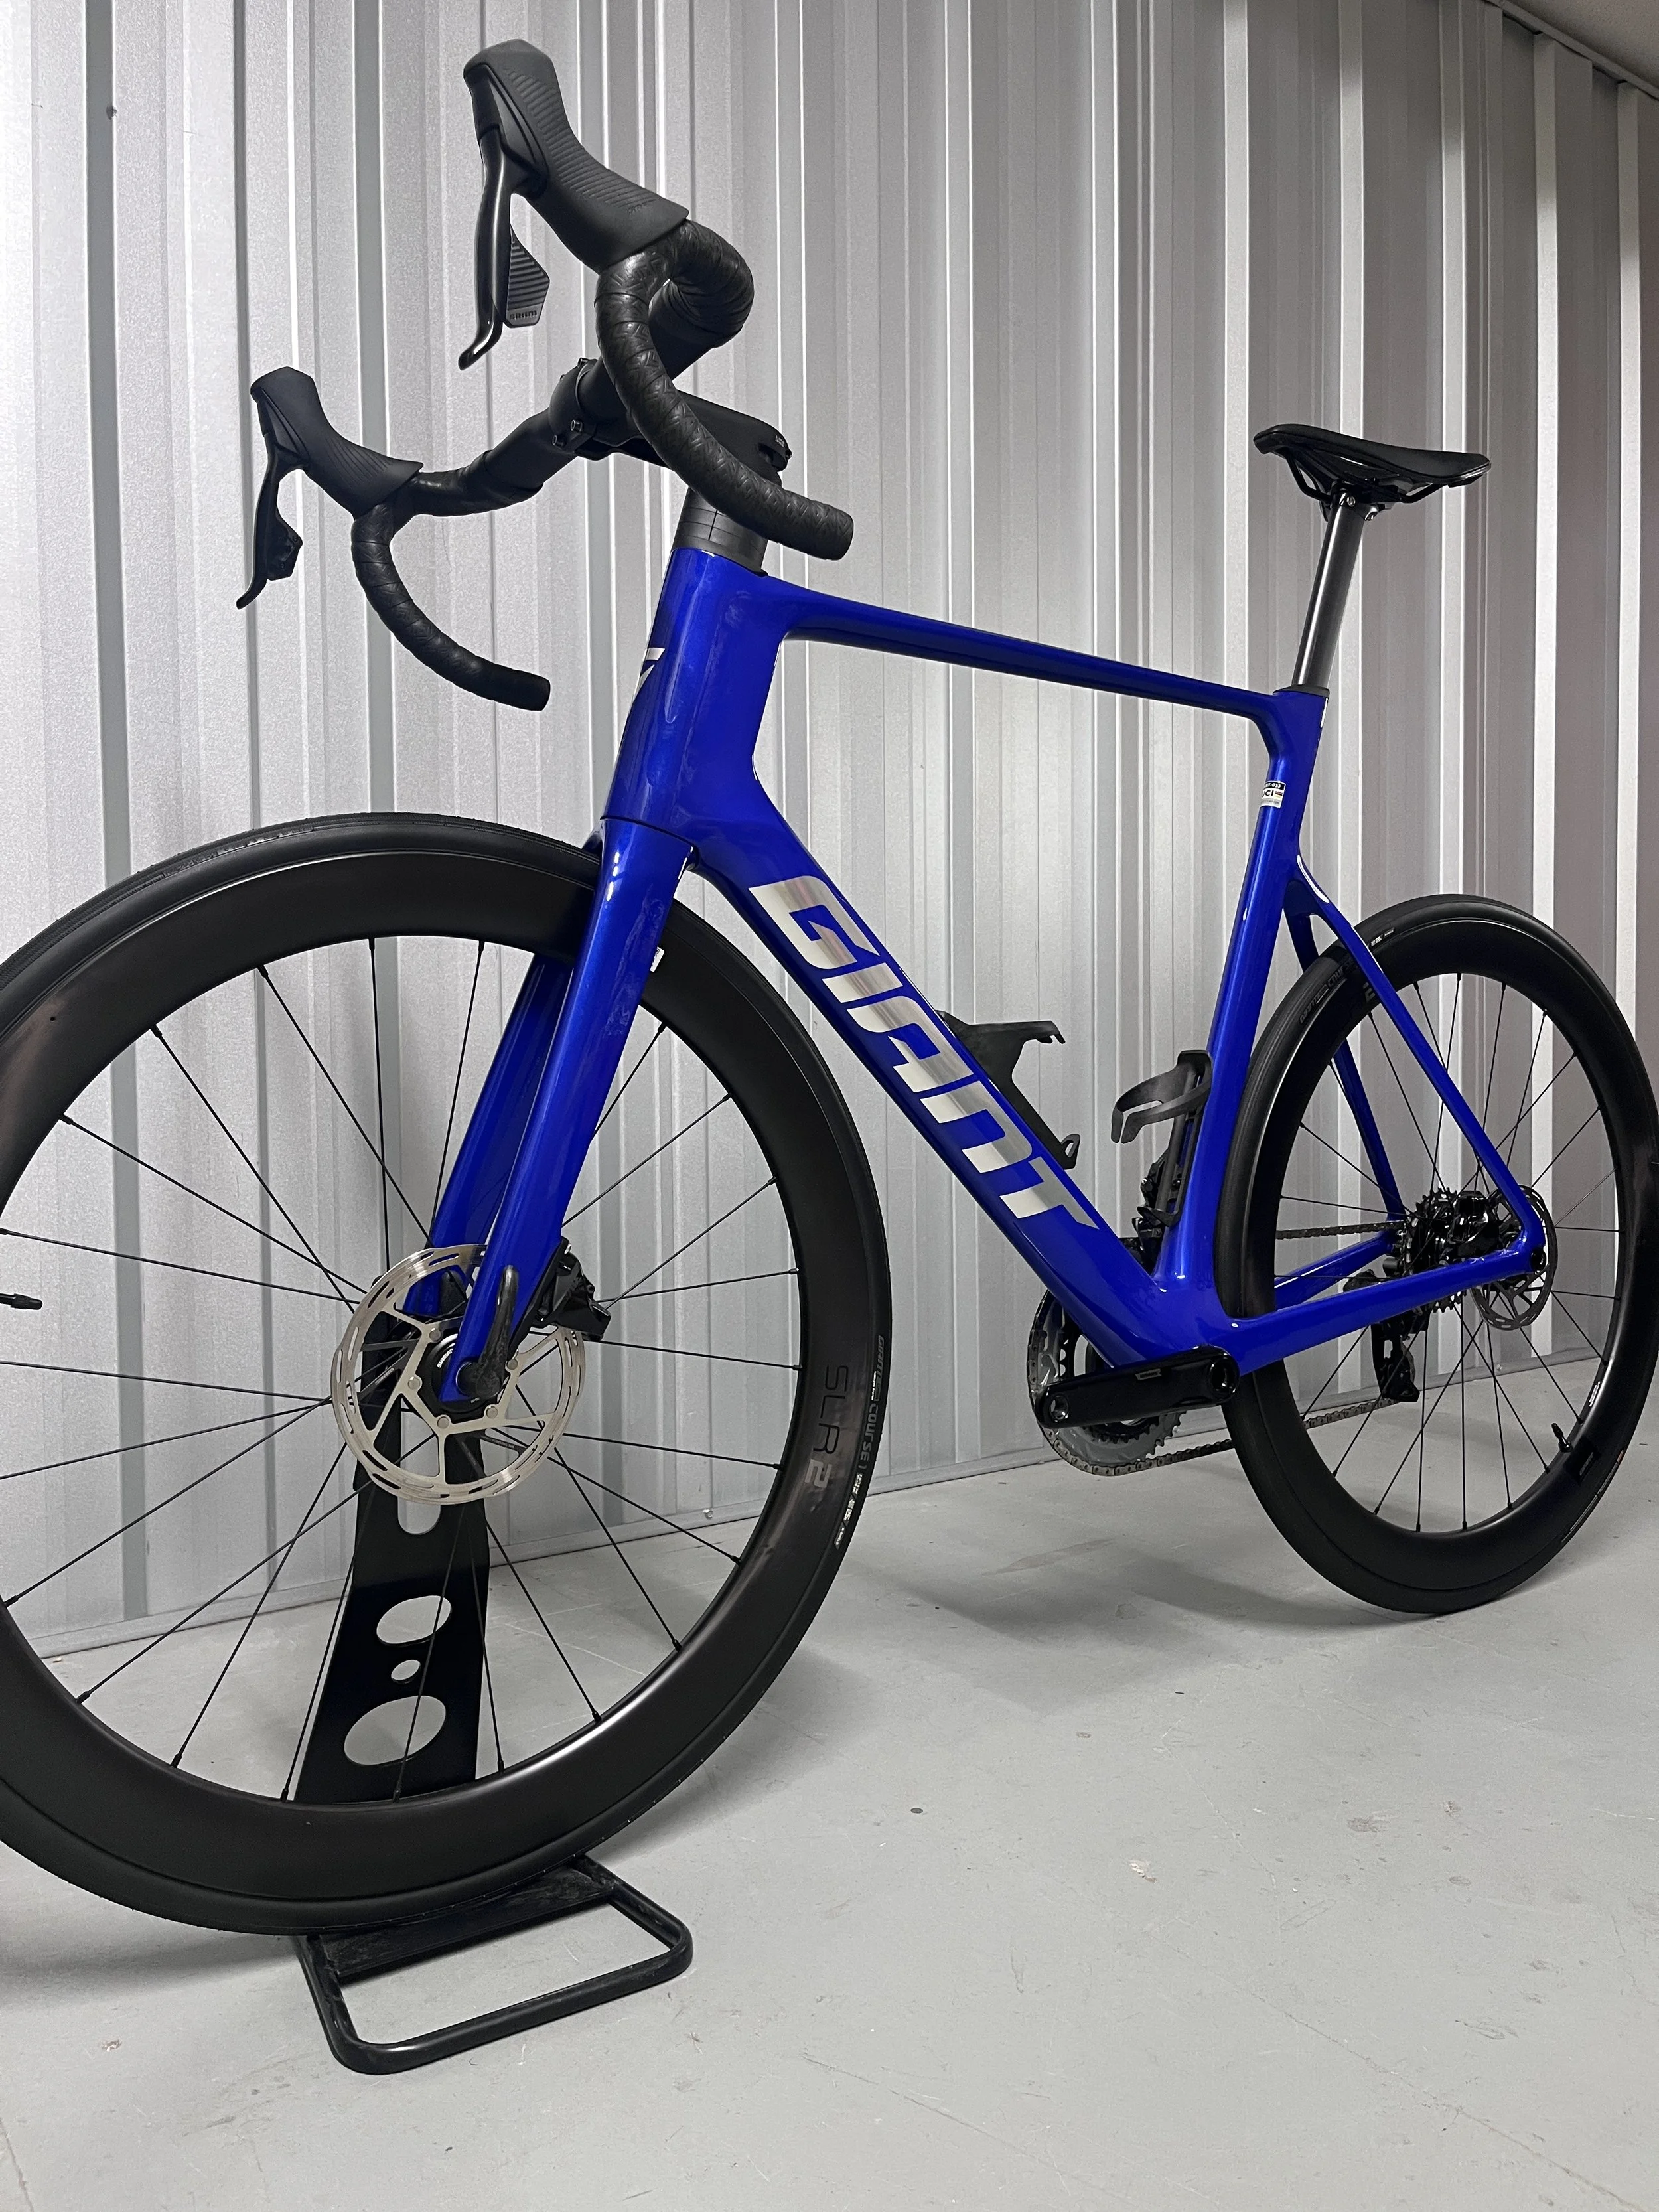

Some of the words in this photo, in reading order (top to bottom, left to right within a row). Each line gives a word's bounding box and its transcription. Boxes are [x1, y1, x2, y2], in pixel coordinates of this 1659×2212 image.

[510, 310, 537, 320] SRAM
[749, 875, 1100, 1229] GIANT
[813, 1364, 849, 1454] SLR
[804, 1459, 833, 1488] 2
